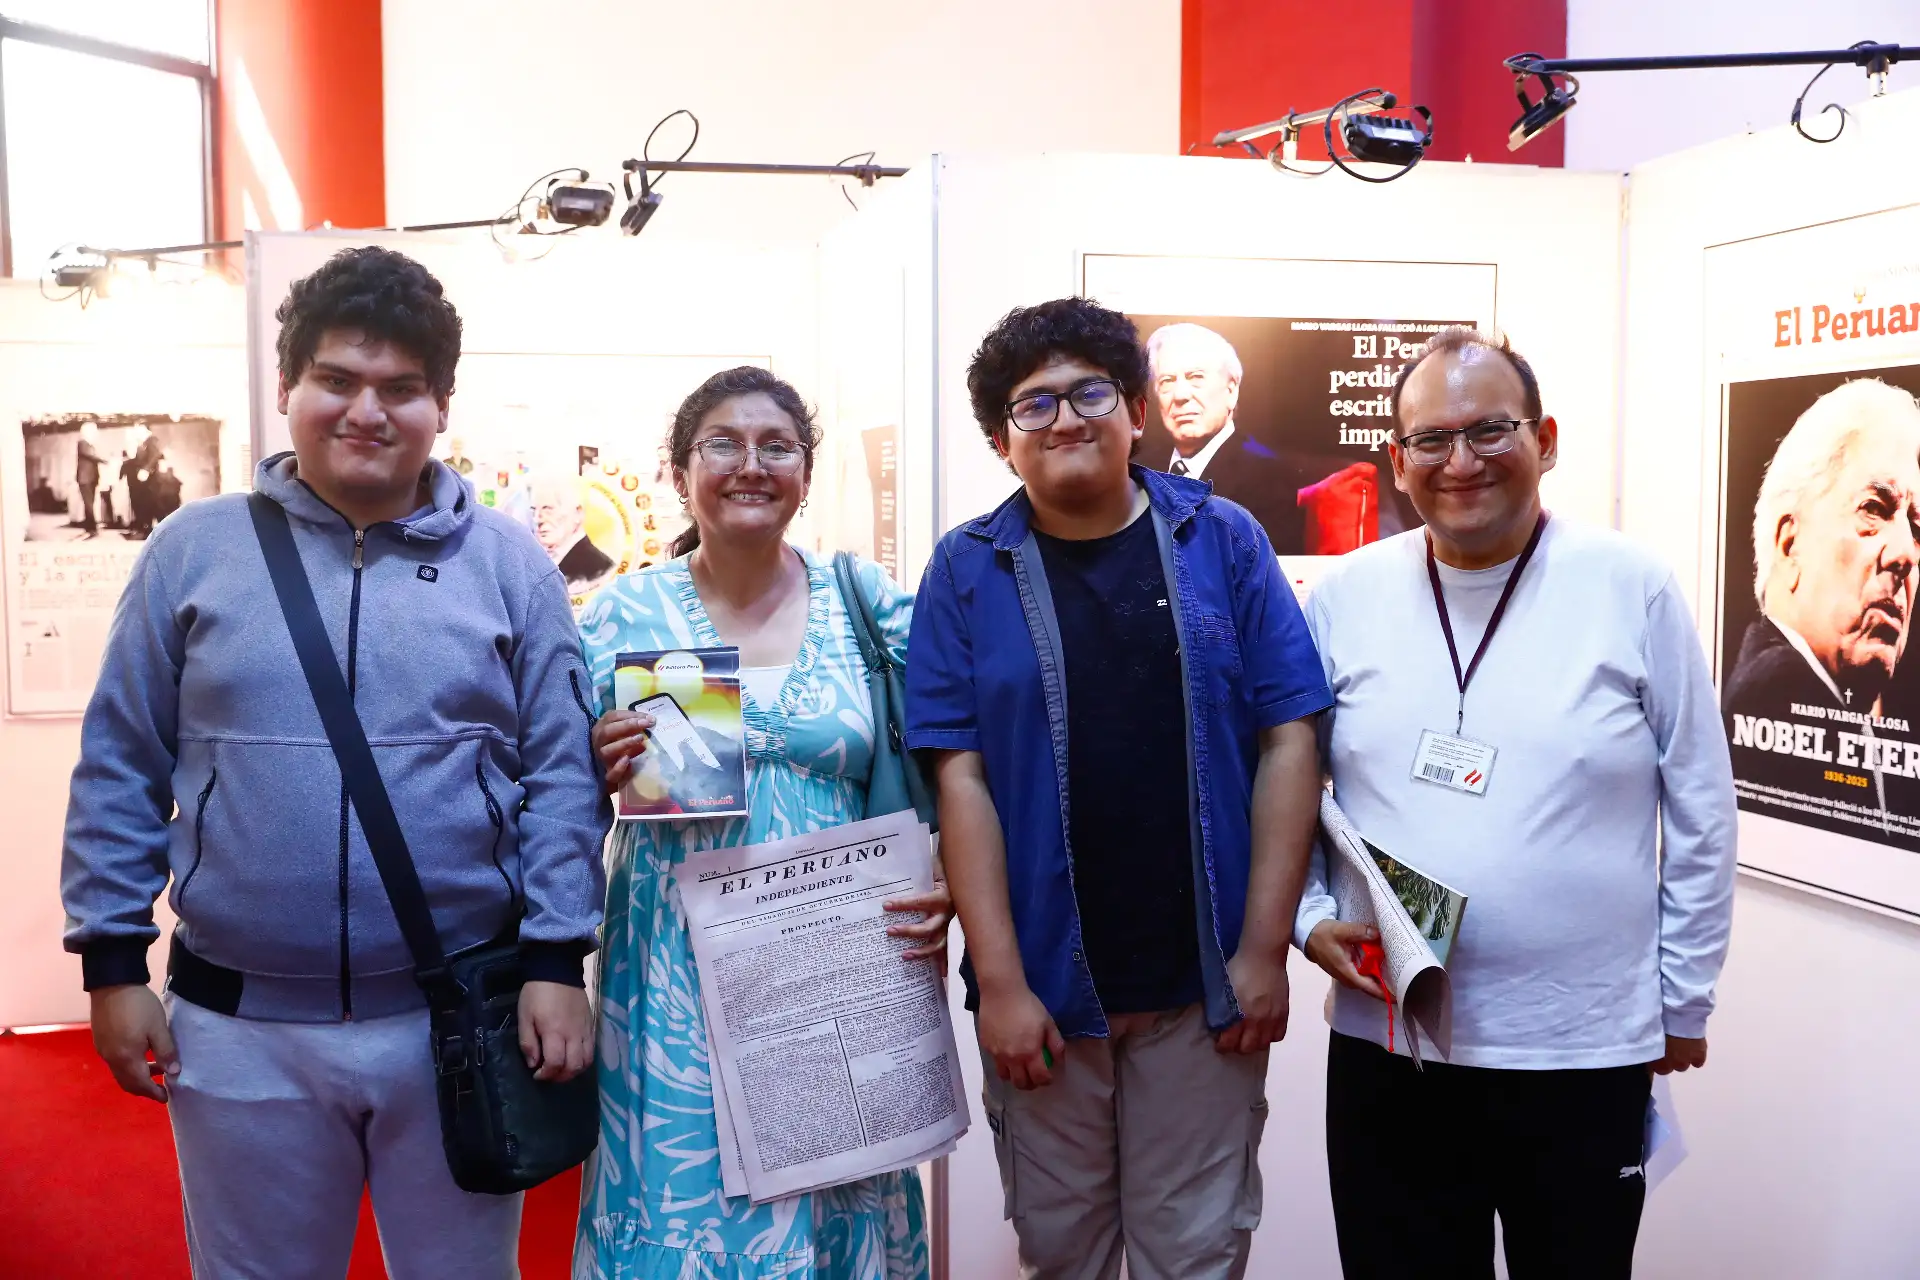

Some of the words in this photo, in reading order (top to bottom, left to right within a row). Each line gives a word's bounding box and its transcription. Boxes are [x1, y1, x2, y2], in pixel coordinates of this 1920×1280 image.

[1774, 306, 1802, 347] El
[1352, 335, 1377, 359] El
[1382, 335, 1426, 360] Per
[1329, 394, 1393, 417] escrit
[1790, 702, 1826, 719] MARIO
[1826, 707, 1871, 725] VARGAS
[1872, 715, 1910, 732] LLOSA
[1732, 713, 1833, 763] NOBEL
[1836, 731, 1920, 780] ETER
[698, 870, 721, 880] NUM.
[719, 876, 752, 896] EL
[763, 844, 887, 885] PERUANO
[755, 874, 855, 905] INDEPENDIENTE.
[780, 915, 845, 936] PROSPECTO.
